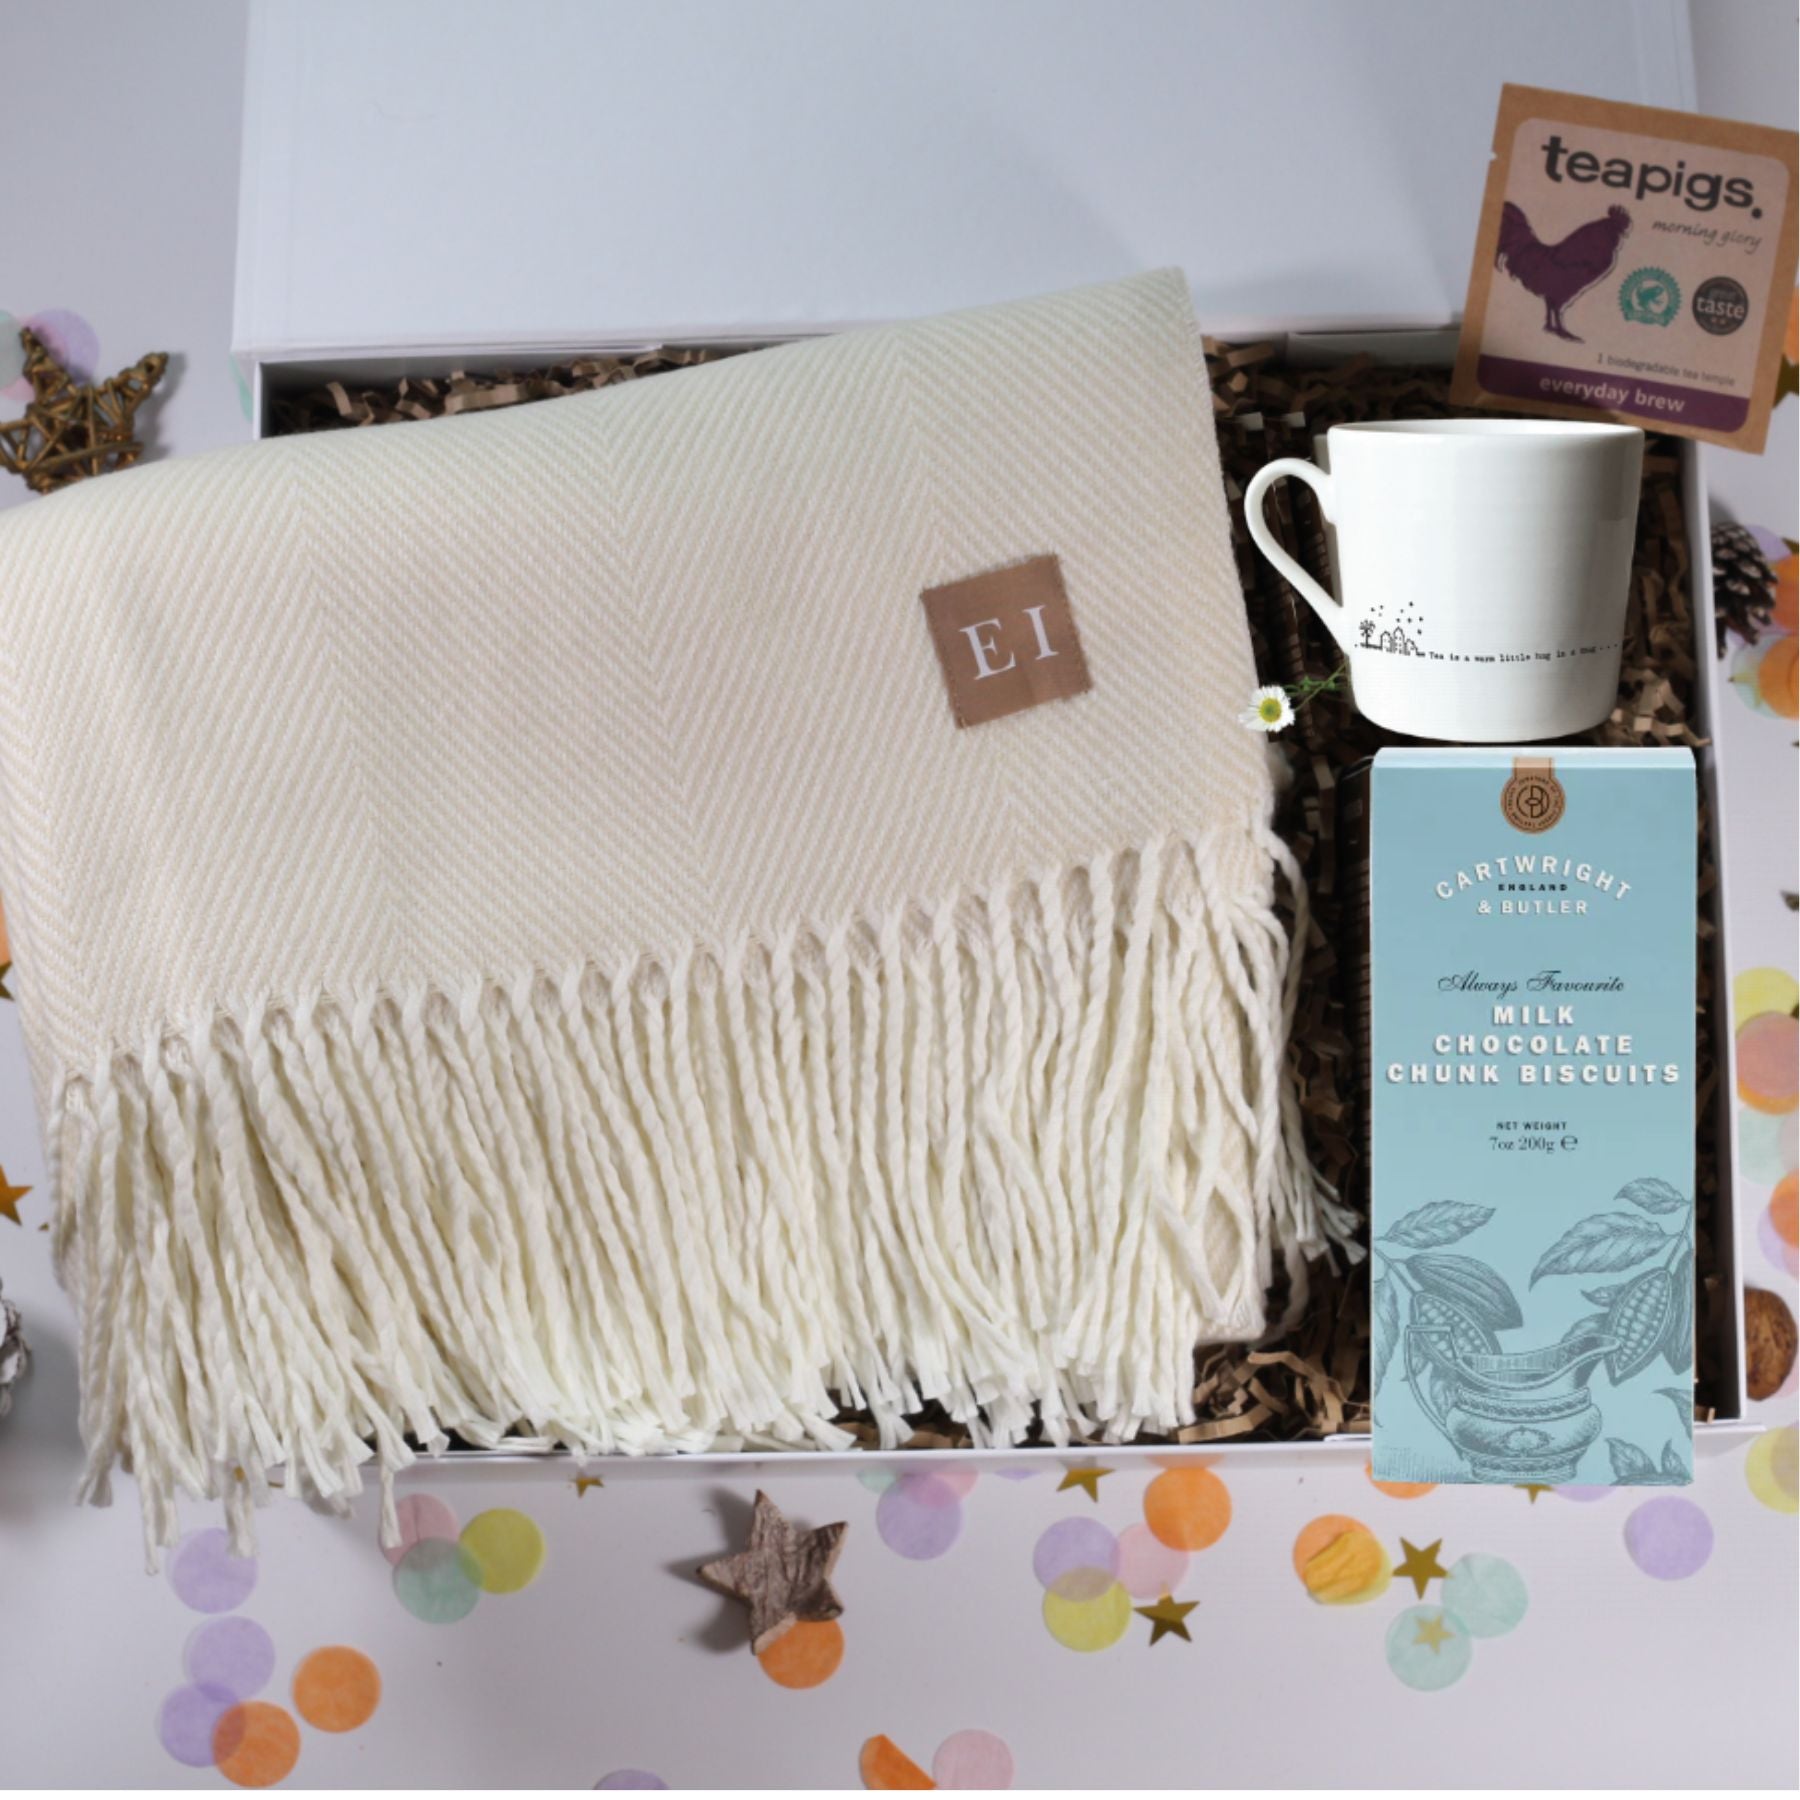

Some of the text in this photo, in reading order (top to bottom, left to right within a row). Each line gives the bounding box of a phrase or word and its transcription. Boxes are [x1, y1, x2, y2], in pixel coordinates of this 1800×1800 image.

[1652, 220, 1763, 255] morning glory
[1696, 297, 1745, 319] taste
[1607, 354, 1681, 377] biodegradable
[1539, 376, 1685, 414] everyday brew
[1429, 651, 1444, 661] Tea
[1500, 653, 1531, 662] little
[1435, 855, 1632, 900] CARTWRIGHT
[1498, 883, 1568, 891] ENGLAND
[1477, 900, 1588, 914] & BUTLER
[1438, 969, 1626, 999] Always Favourite
[1492, 1005, 1575, 1025] MILK
[1434, 1034, 1633, 1055] CHOCOLATE
[1386, 1063, 1680, 1085] CHUNK BISCUITS
[1496, 1121, 1568, 1131] NET WEIGHT
[1489, 1136, 1515, 1151] 7oz
[1518, 1136, 1555, 1154] 200g
